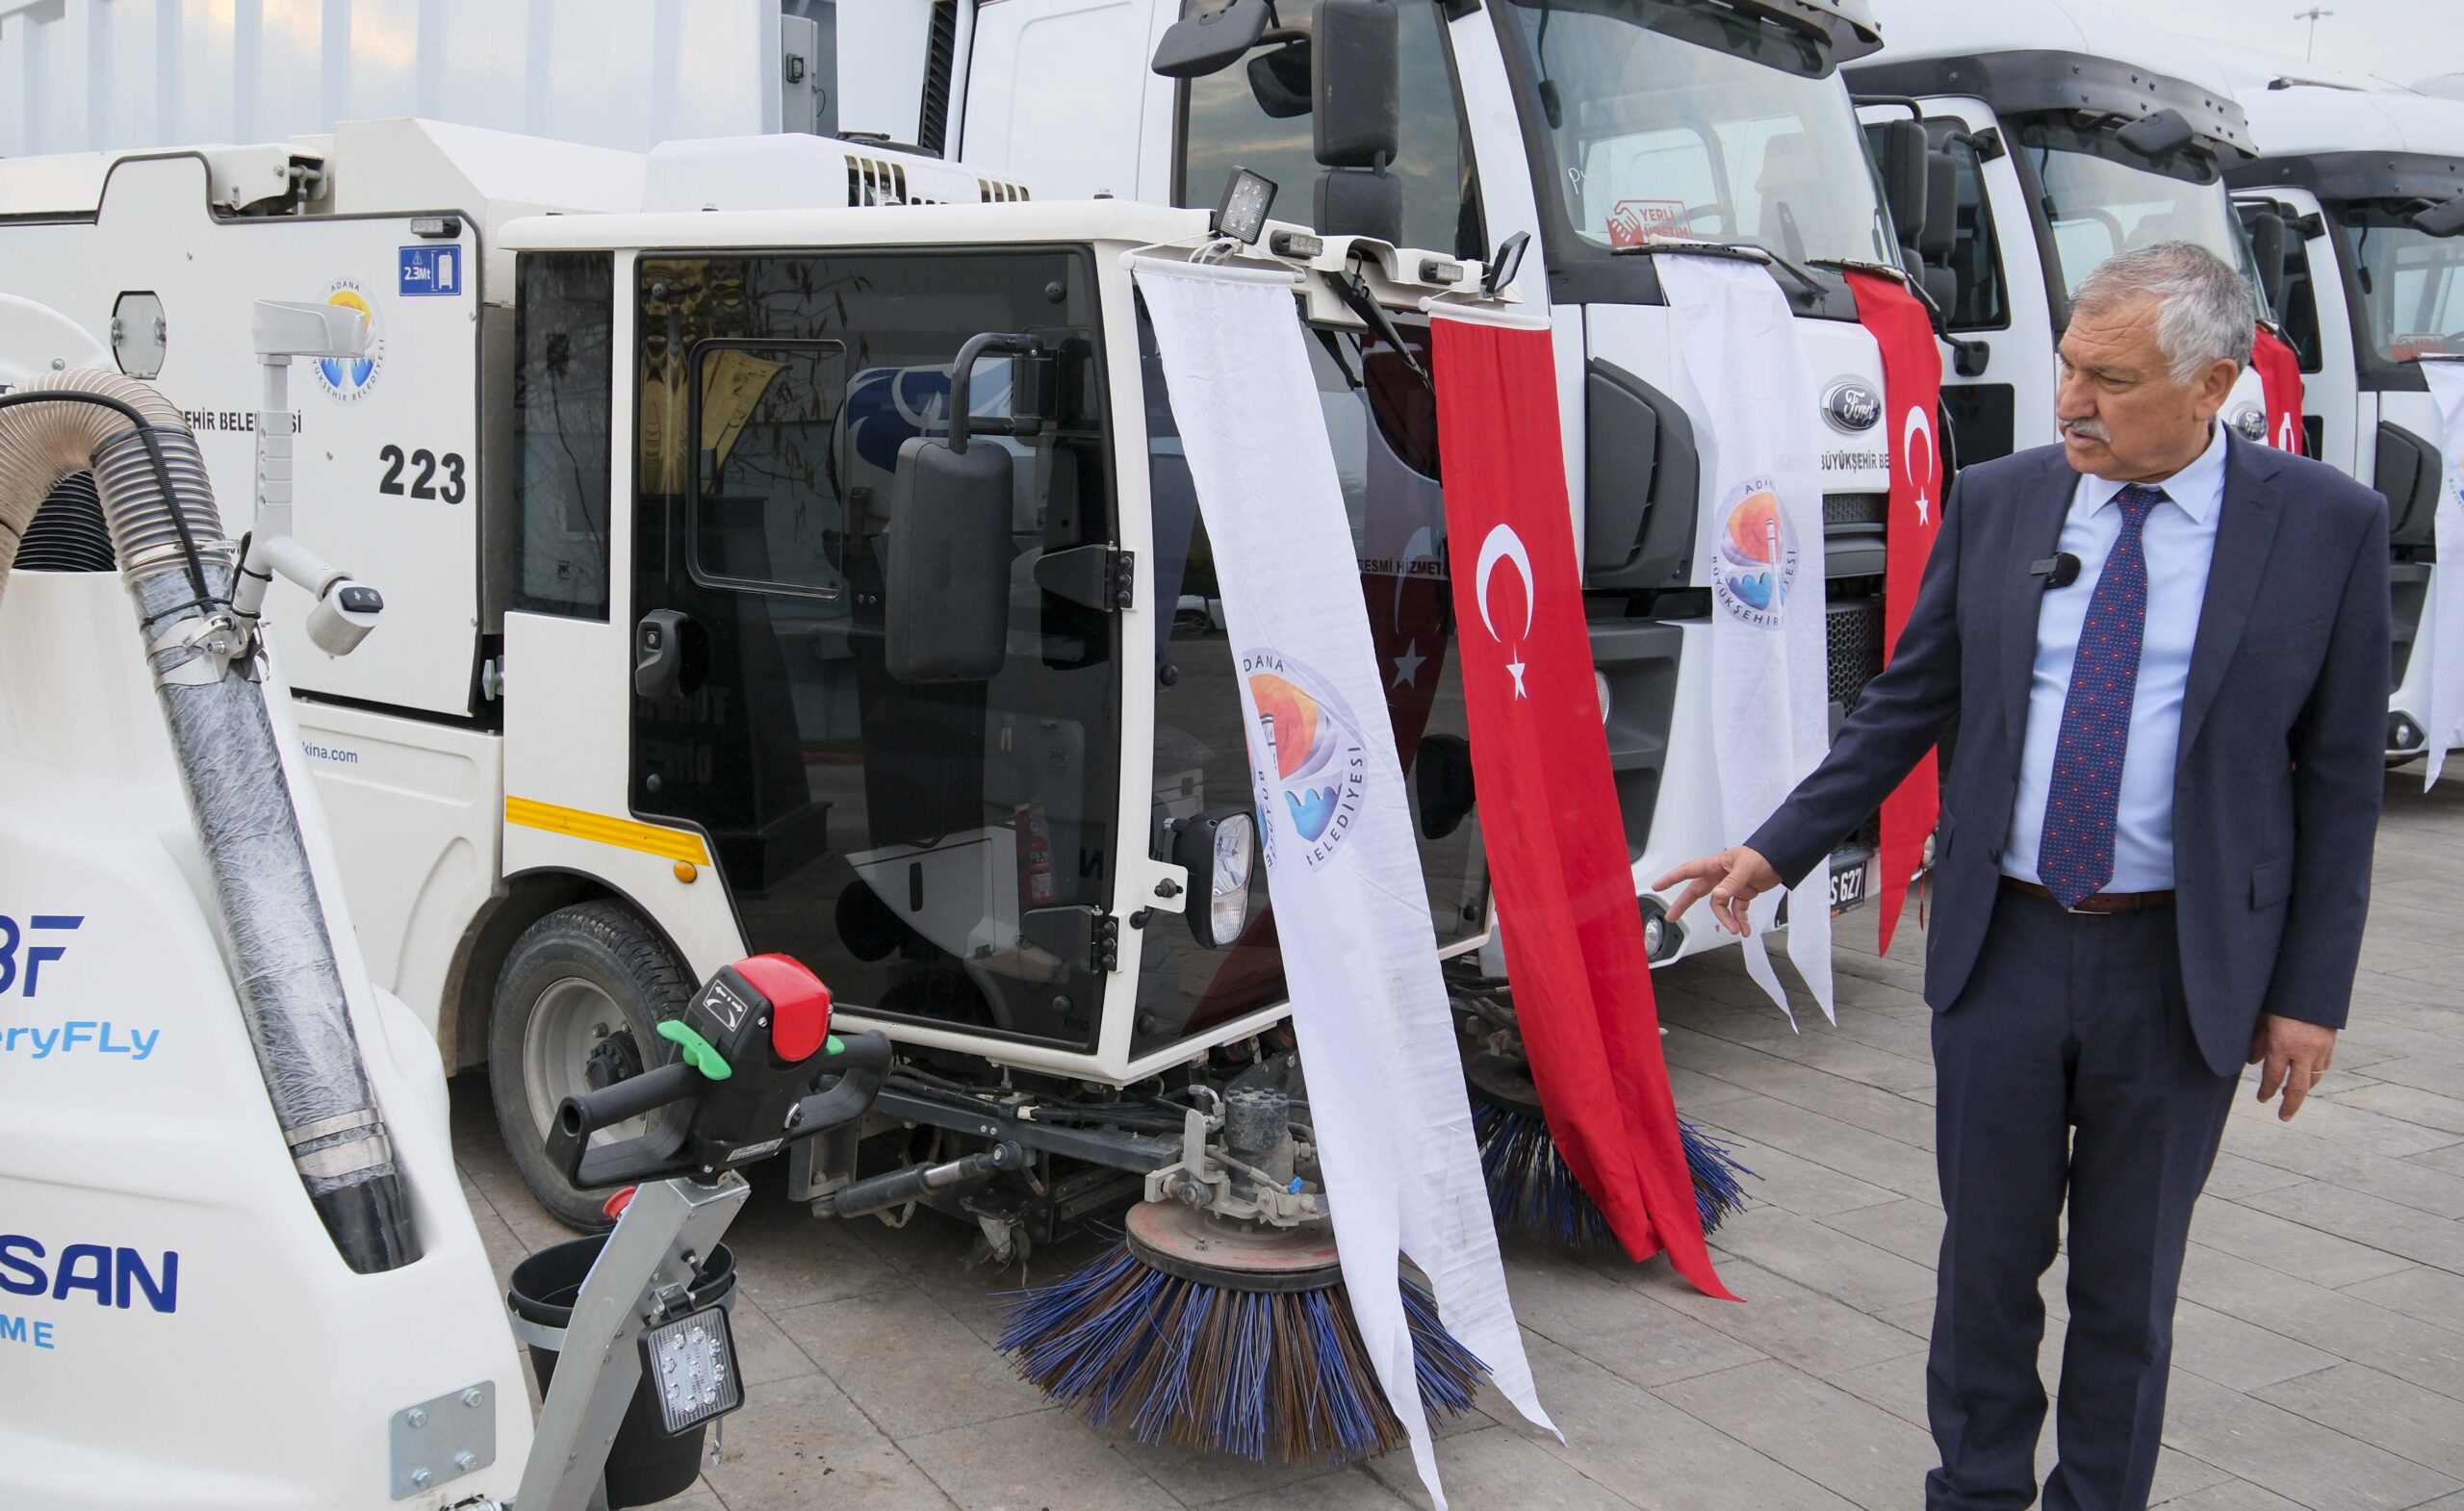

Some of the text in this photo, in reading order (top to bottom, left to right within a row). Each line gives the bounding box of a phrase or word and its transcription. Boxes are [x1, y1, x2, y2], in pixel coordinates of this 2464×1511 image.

[1639, 205, 1674, 221] YERLİ
[330, 280, 360, 293] ADANA
[404, 266, 431, 281] 2.3Mt
[179, 406, 217, 431] EHİR
[1843, 389, 1875, 420] Ford
[379, 444, 466, 504] 223
[1839, 867, 1862, 902] 627
[0, 1021, 160, 1061] ryFLy
